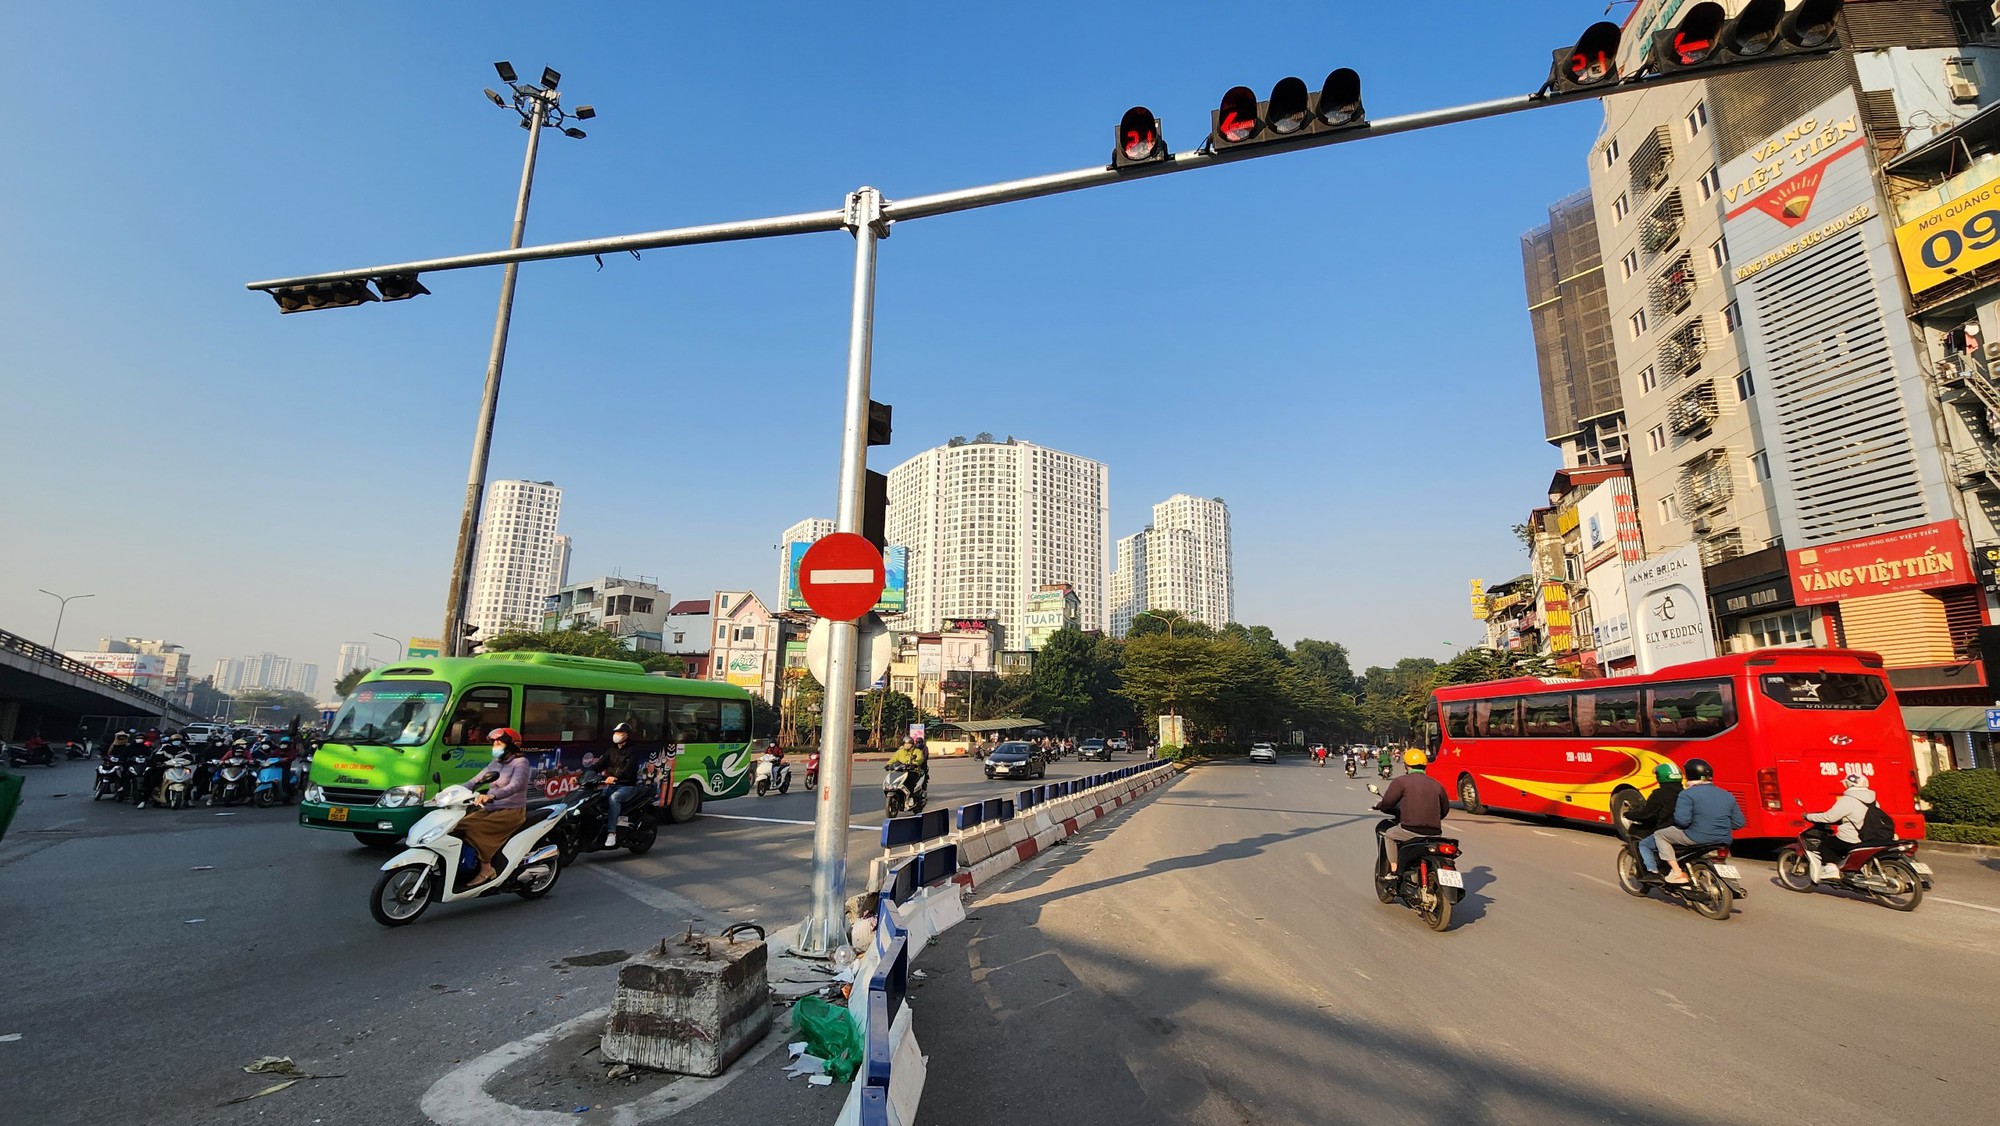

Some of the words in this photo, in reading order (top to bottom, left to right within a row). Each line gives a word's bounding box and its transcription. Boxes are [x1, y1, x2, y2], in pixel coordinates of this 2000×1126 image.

[1752, 118, 1818, 163] VÀNG
[1723, 160, 1784, 203] VIỆT
[1791, 114, 1858, 166] TIẾN
[1918, 213, 1943, 231] MỜI
[1945, 191, 1990, 218] QUẢNG
[1735, 261, 1763, 279] VÀNG
[1764, 243, 1799, 266] TRANG
[1800, 228, 1822, 248] SỨC
[1823, 218, 1845, 236] CAO
[1846, 205, 1870, 226] CẤP
[1921, 209, 2000, 269] 09
[1899, 532, 1919, 541] VIỆT
[1919, 527, 1939, 537] TIẾN
[1632, 569, 1653, 584] ANNE
[1656, 558, 1688, 576] BRIDAL
[1799, 568, 1855, 592] VÀNG
[1853, 557, 1902, 586] VIỆT
[1903, 545, 1954, 578] TIẾN
[1027, 592, 1060, 600] Kangaroo
[1024, 613, 1062, 624] TUART
[1646, 632, 1660, 644] ELY
[1662, 622, 1703, 640] WEDDING
[1820, 762, 1838, 776] 29B
